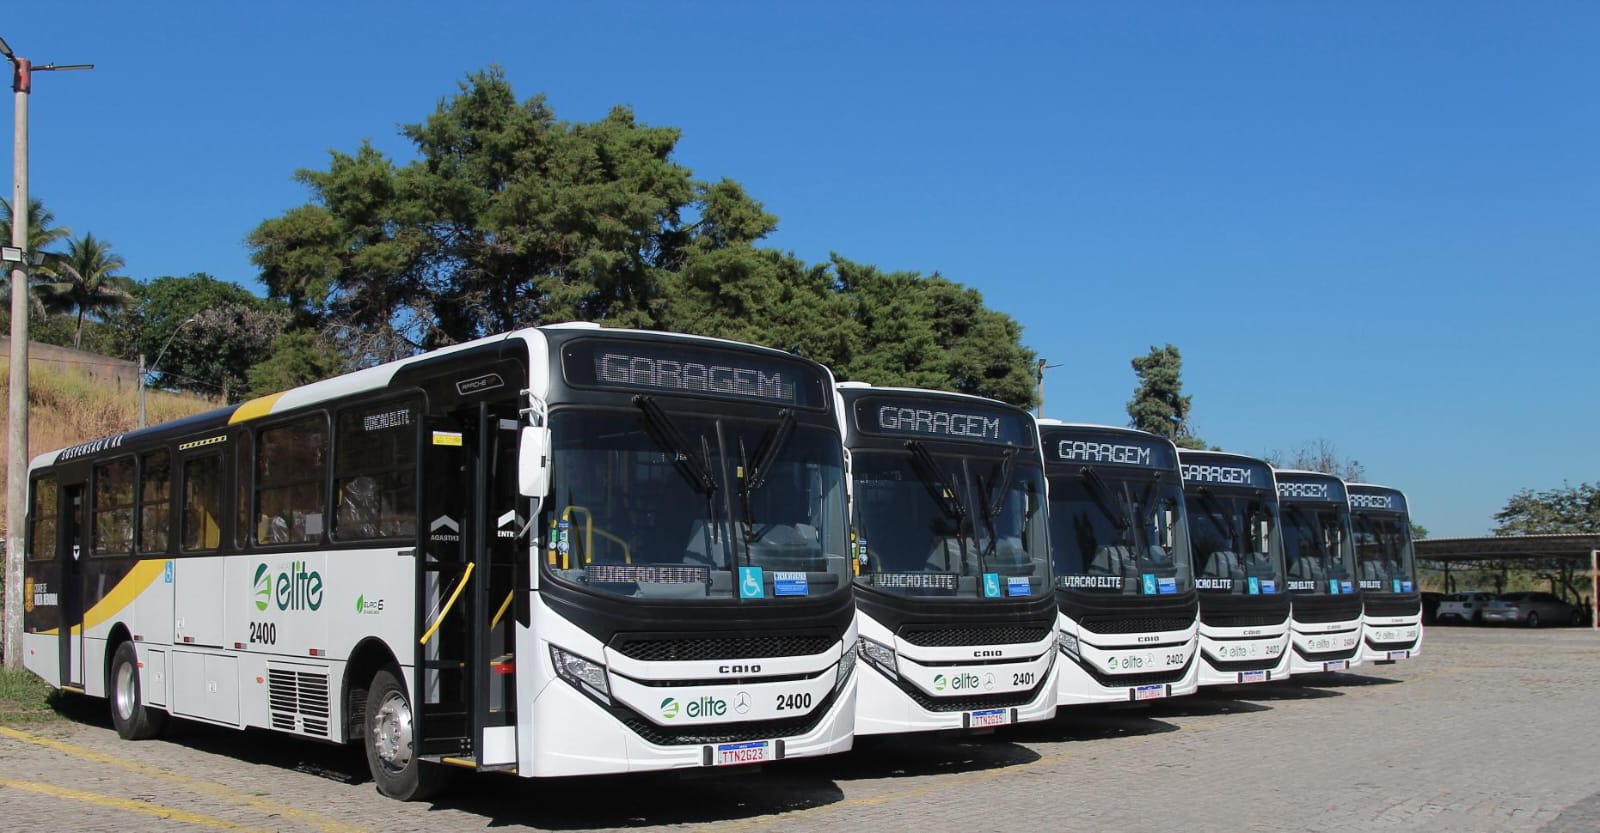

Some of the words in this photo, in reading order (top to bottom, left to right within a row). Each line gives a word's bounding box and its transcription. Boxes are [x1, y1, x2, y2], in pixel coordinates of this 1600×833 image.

[602, 353, 781, 399] GARAGEM
[390, 409, 410, 426] ELITE
[879, 406, 999, 439] GARAGEM
[1059, 440, 1150, 465] GARAGEM
[1180, 463, 1251, 484] GARAGEM
[1278, 482, 1328, 498] ARAGEM
[1350, 494, 1392, 508] ARAGEM
[276, 561, 323, 611] elite
[879, 573, 920, 588] VIACAO
[922, 574, 953, 590] ELITE
[1064, 576, 1096, 588] VIACAO
[1098, 576, 1121, 588] ELITE
[1212, 579, 1231, 590] ELITE
[378, 599, 384, 610] 6
[250, 621, 276, 645] 2400
[1122, 655, 1143, 669] elite
[1166, 653, 1184, 665] 2402
[719, 664, 761, 674] CAIO
[952, 672, 979, 690] elite
[1012, 672, 1035, 686] 2401
[686, 696, 727, 718] elite
[776, 692, 812, 711] 2400
[722, 748, 764, 763] TTN2G23
